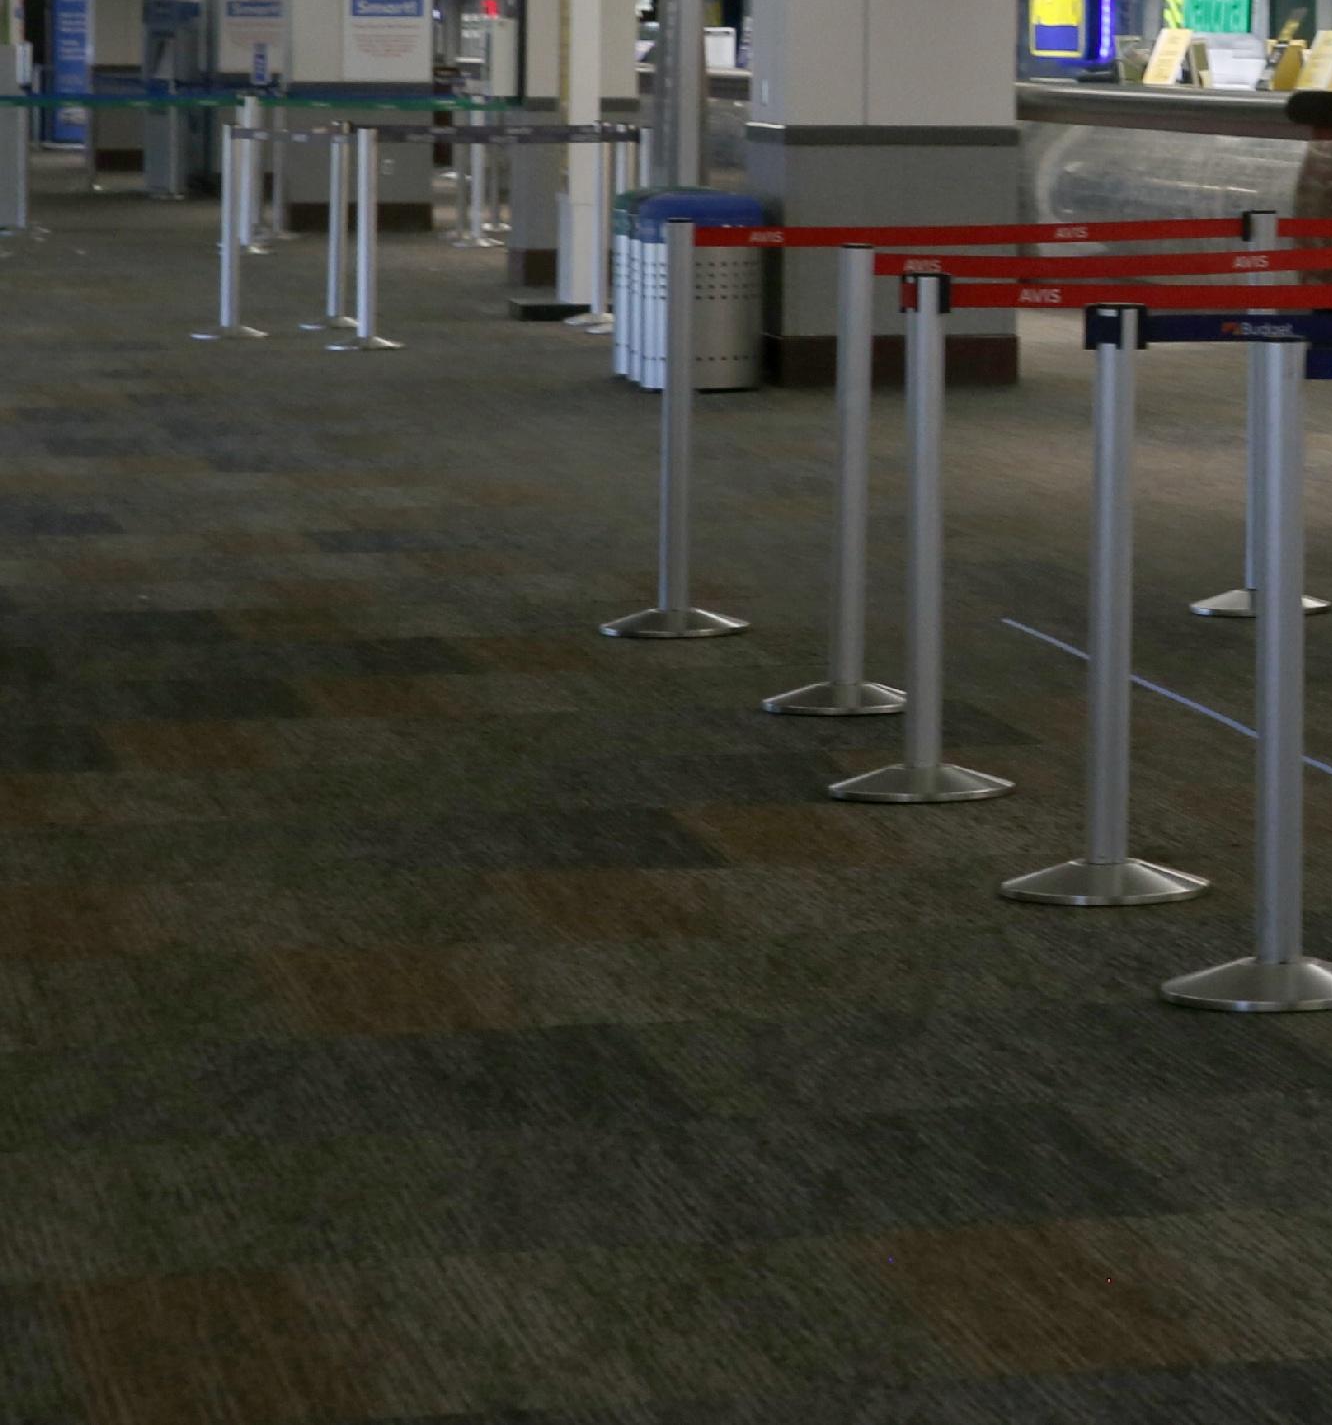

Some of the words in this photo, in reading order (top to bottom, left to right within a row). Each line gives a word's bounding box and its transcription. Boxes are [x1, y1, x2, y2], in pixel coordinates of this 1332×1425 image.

[749, 231, 784, 243] AVIS
[1054, 226, 1088, 238] AVIS
[903, 259, 941, 273] AVIS
[1233, 255, 1269, 268] AVIS
[1019, 289, 1061, 304] AVIS
[1241, 323, 1294, 337] Budget
